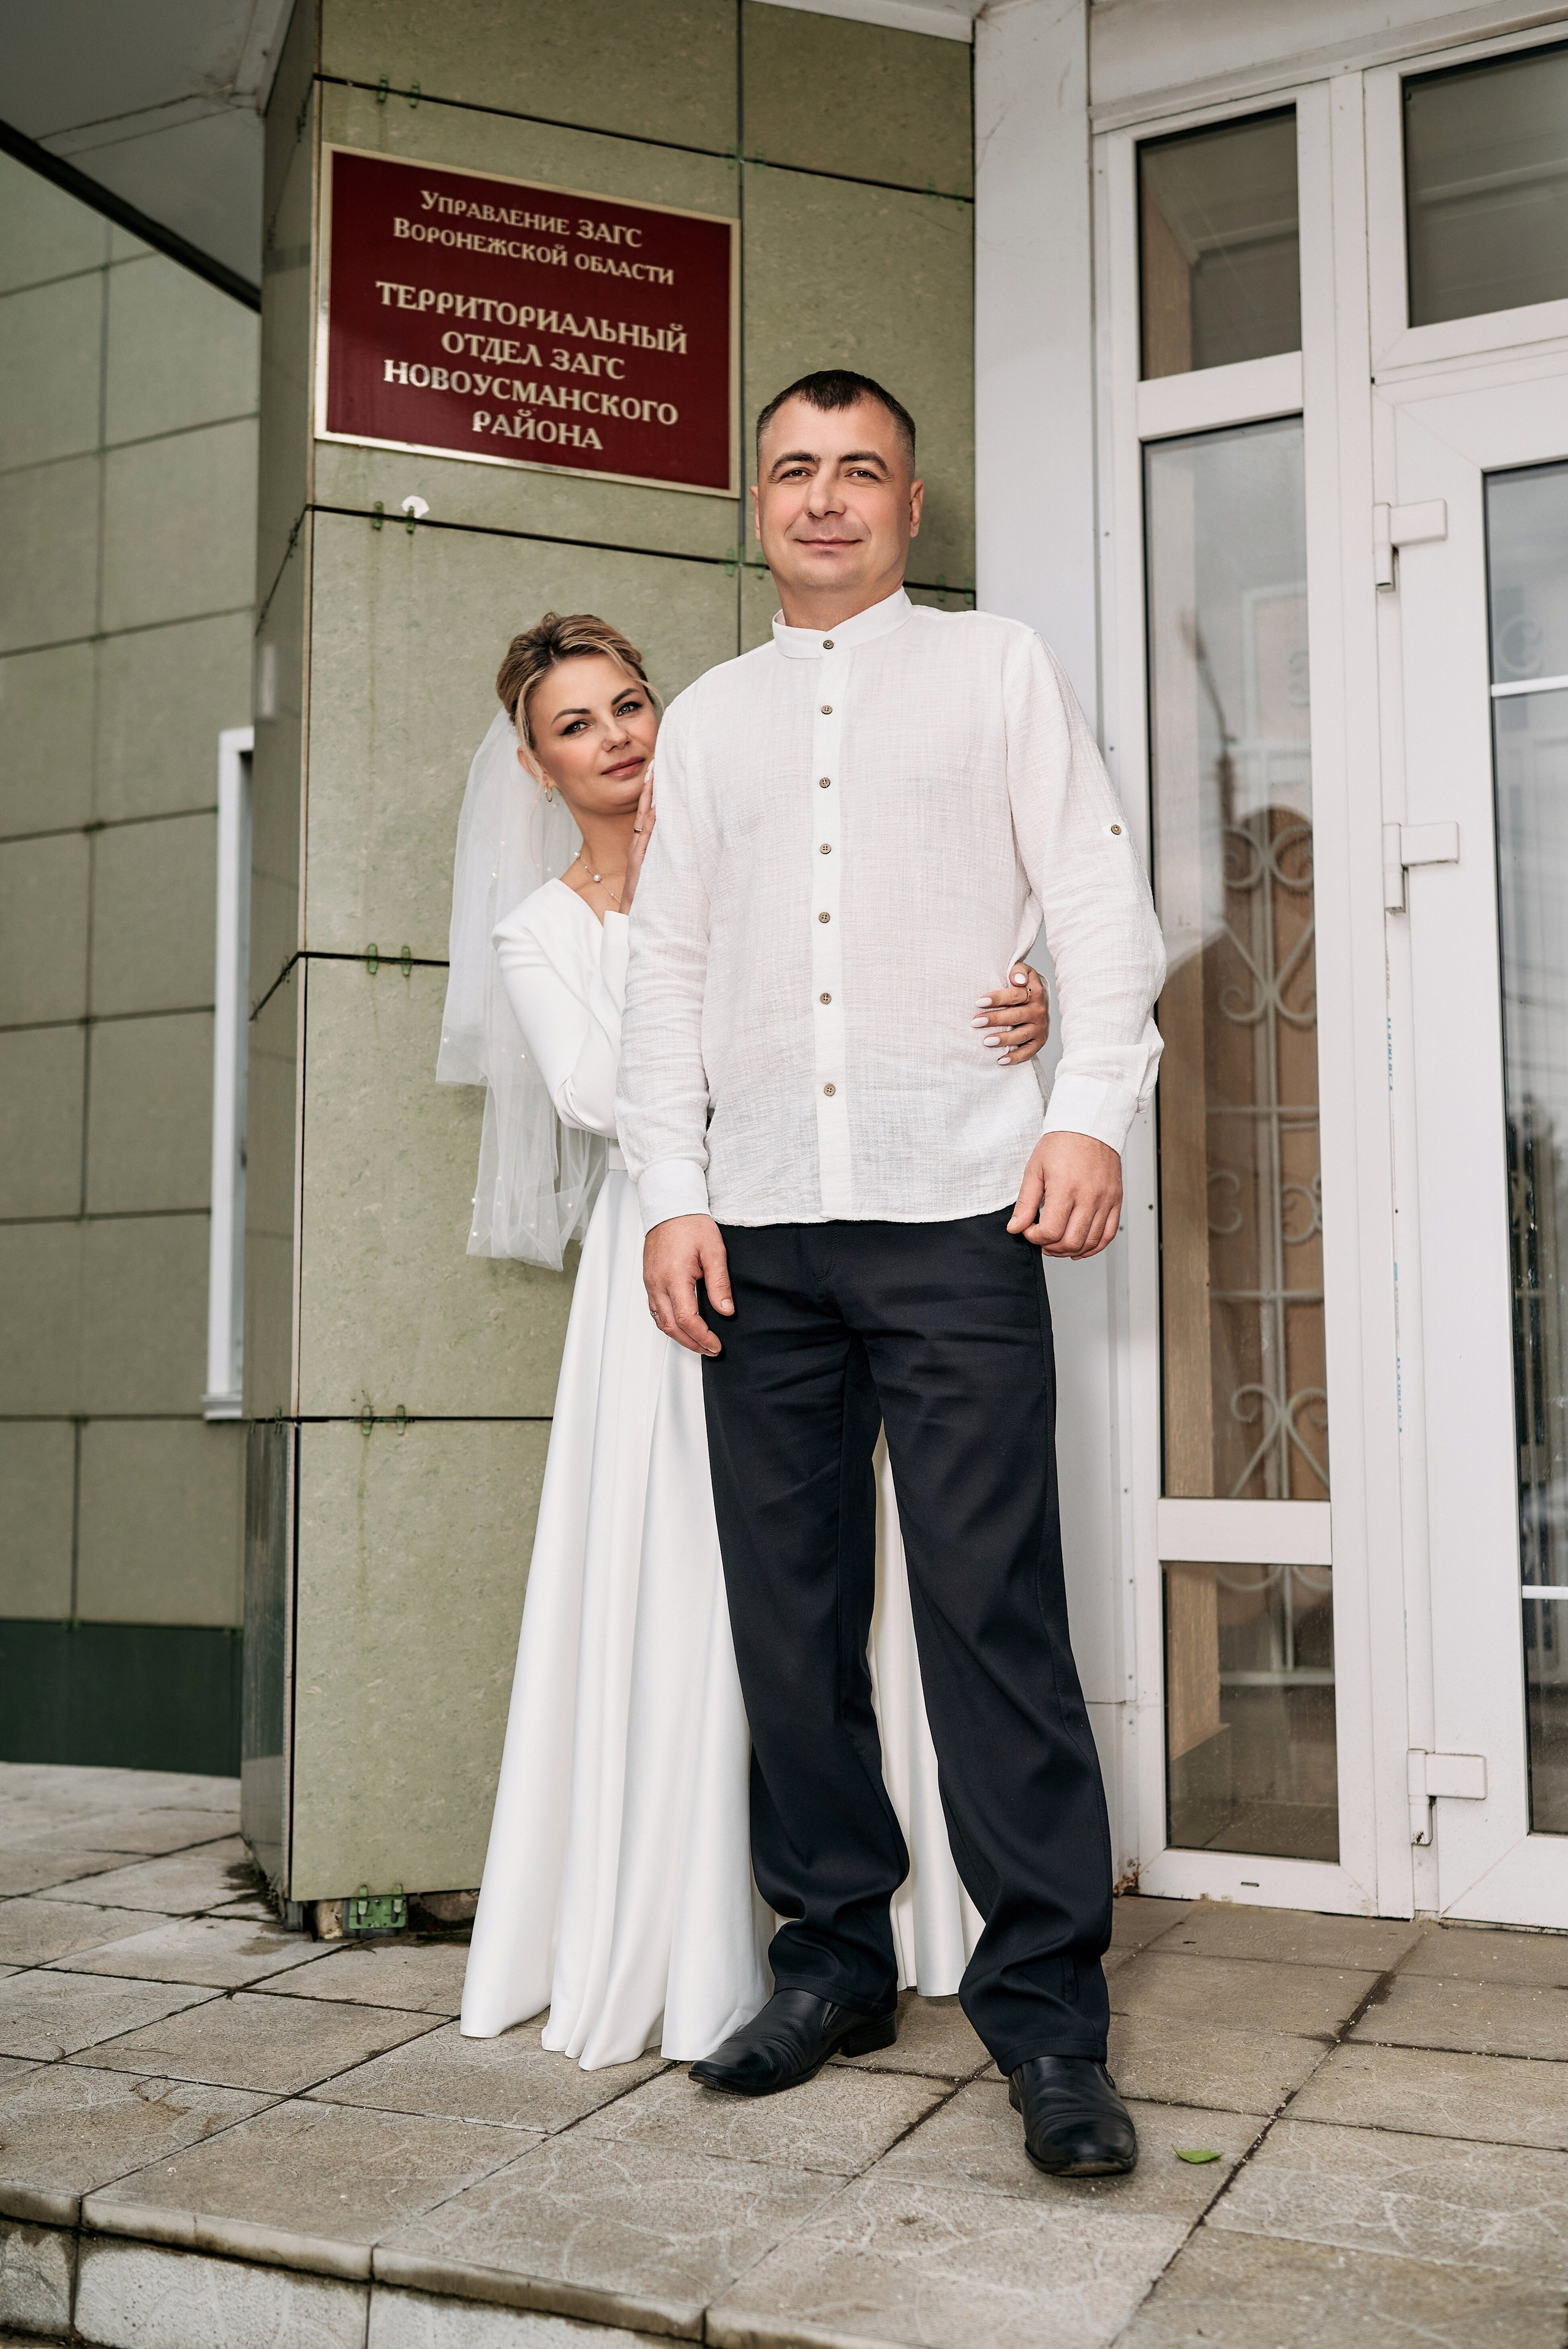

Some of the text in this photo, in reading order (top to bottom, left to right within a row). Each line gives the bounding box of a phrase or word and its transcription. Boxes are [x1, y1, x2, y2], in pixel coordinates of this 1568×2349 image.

[576, 219, 642, 247] ЗАГС
[574, 253, 674, 285] ОБЛАСТИ
[375, 281, 687, 355] ТЕРРИТОРИАЛЬНЫЙ
[441, 331, 625, 380] ОТДЕЛ ЗАГС
[383, 358, 679, 425] НОВОУСМАНСКОГО
[471, 409, 603, 450] РАЙОНА
